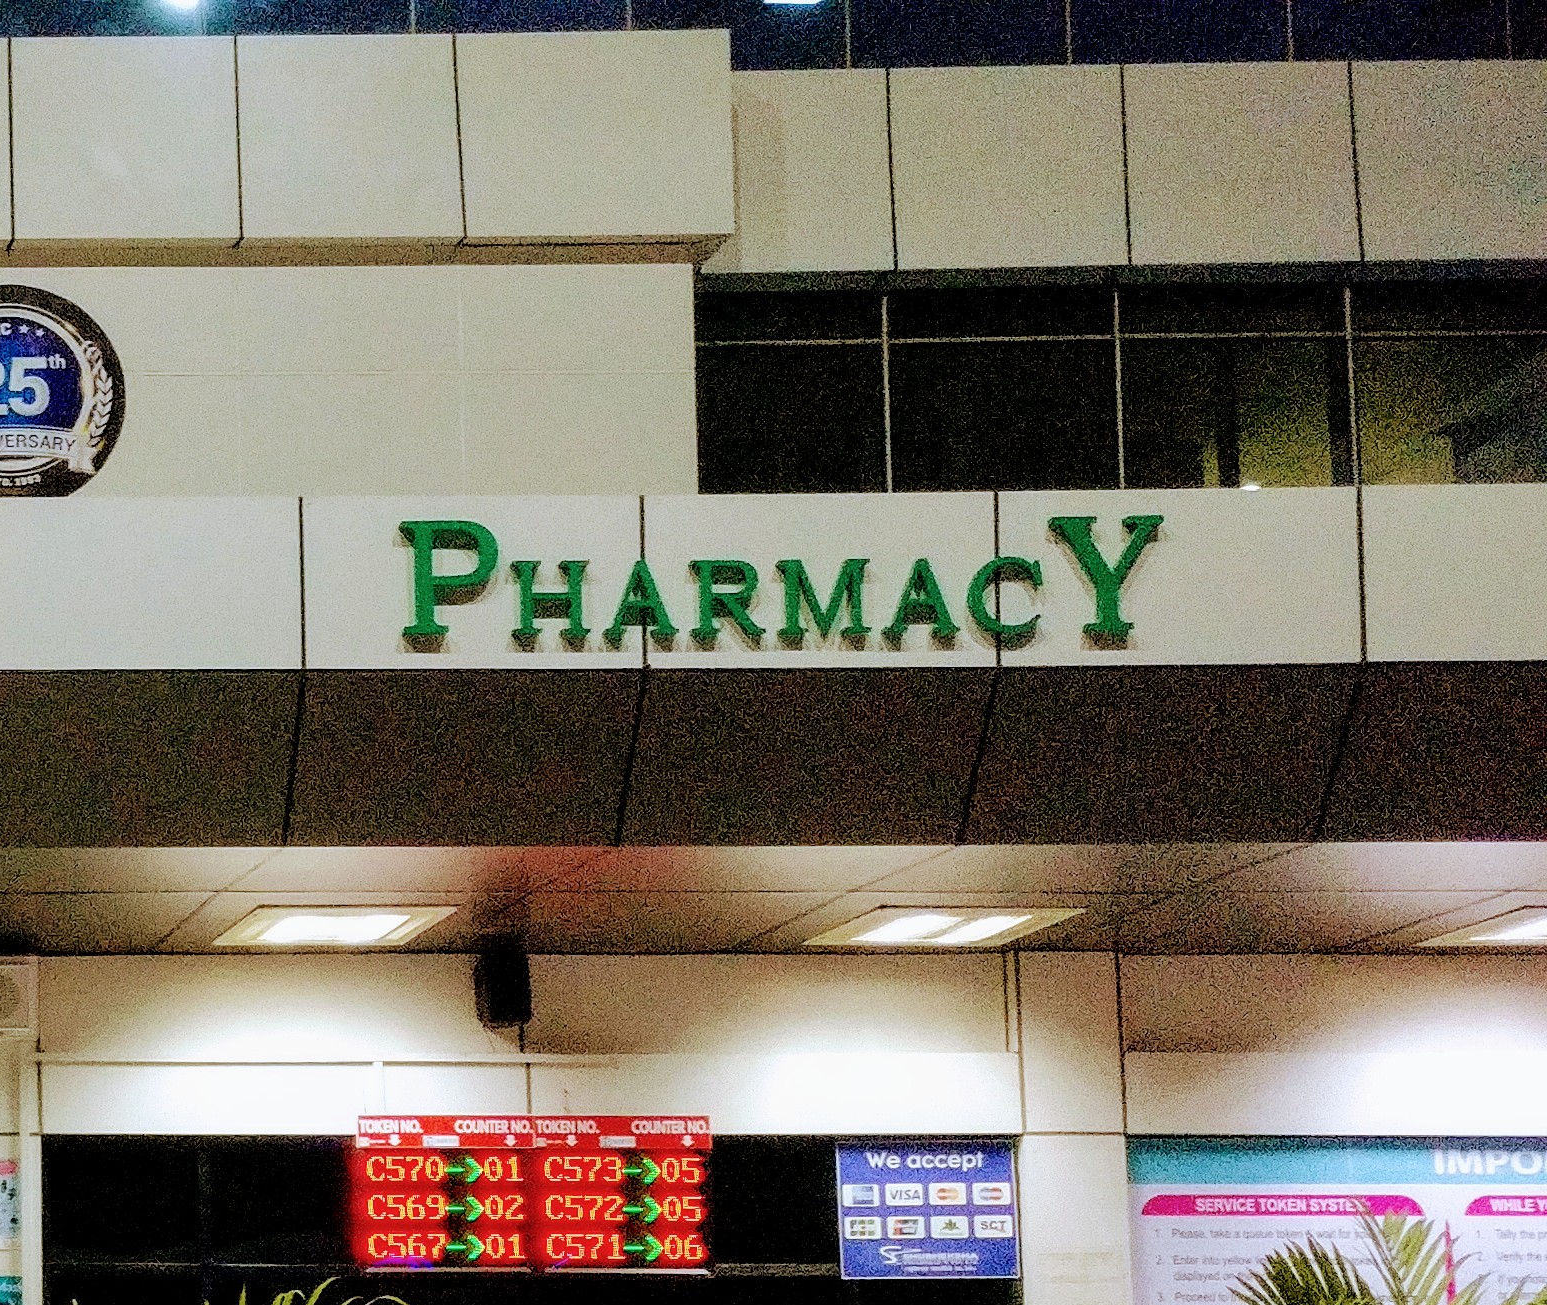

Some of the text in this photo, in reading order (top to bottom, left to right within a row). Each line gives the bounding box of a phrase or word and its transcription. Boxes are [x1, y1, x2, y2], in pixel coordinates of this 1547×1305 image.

[359, 1120, 423, 1134] TOKEN NO.
[454, 1120, 533, 1134] COUNTER NO.
[535, 1120, 600, 1134] TOKEN NO.
[631, 1120, 685, 1135] COUNTER
[365, 1156, 524, 1182] C570 01
[543, 1156, 701, 1182] C573 05
[865, 1152, 984, 1172] We accept
[1434, 1151, 1547, 1175] IMPO
[890, 1188, 921, 1200] VISA
[367, 1194, 525, 1220] C569 02
[544, 1194, 702, 1220] C572 05
[1195, 1199, 1369, 1212] SERVICE TOKEN SYSTE
[1490, 1199, 1535, 1212] WHILE
[980, 1220, 1007, 1232] SCT
[1210, 1229, 1231, 1238] take
[1277, 1229, 1300, 1238] token
[1338, 1229, 1351, 1238] for
[1495, 1229, 1517, 1241] Tally
[1520, 1230, 1536, 1239] the
[367, 1233, 525, 1260] C567 01
[546, 1233, 703, 1260] C571 06
[1173, 1256, 1198, 1265] Enter
[1223, 1255, 1251, 1268] yellow
[1173, 1271, 1224, 1283] displayed
[1174, 1292, 1215, 1301] Proceed
